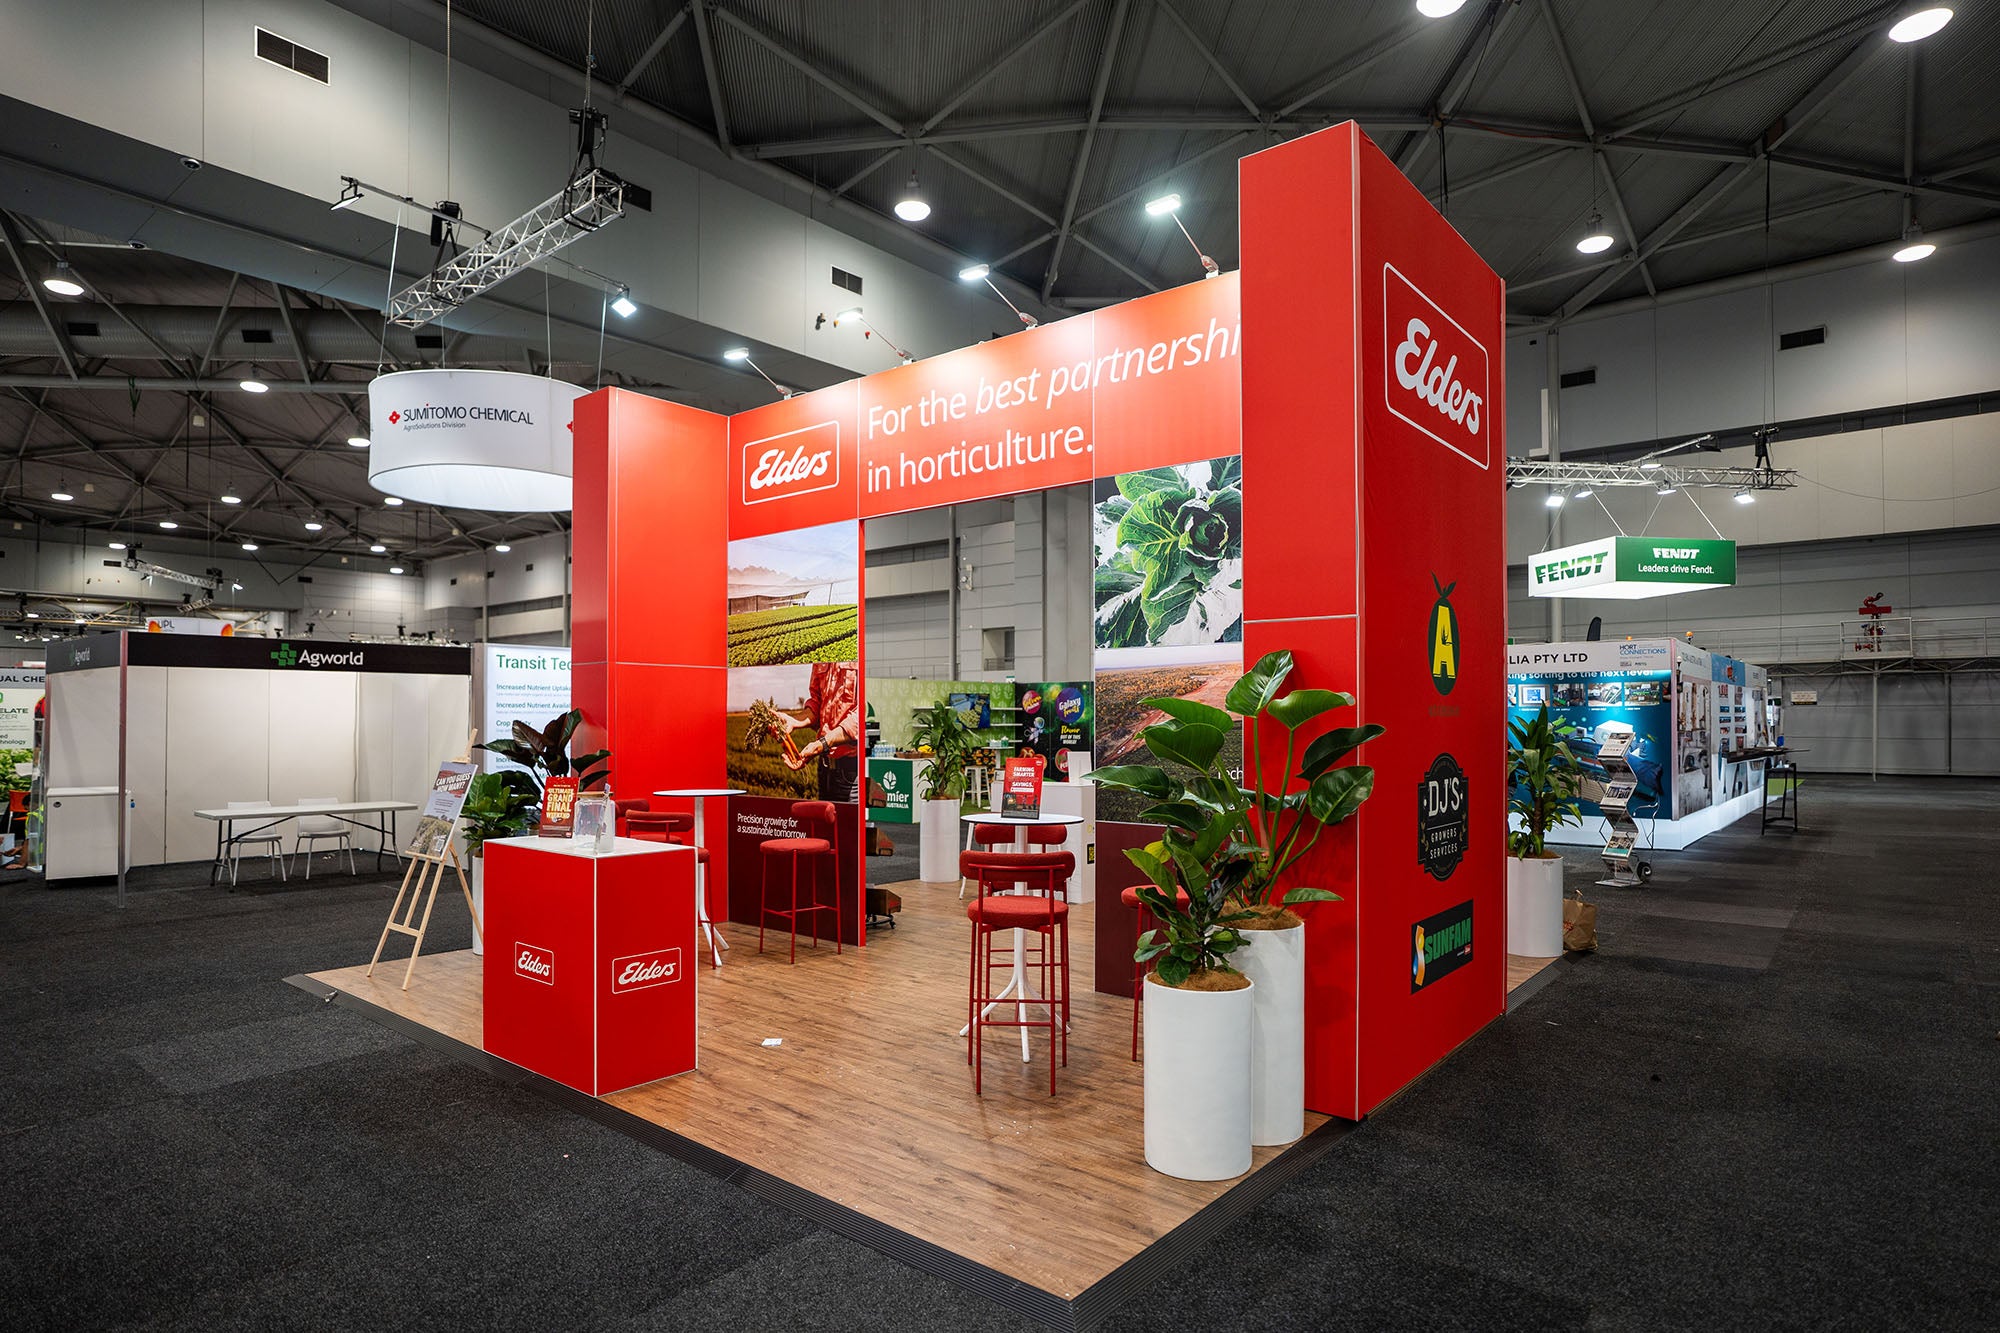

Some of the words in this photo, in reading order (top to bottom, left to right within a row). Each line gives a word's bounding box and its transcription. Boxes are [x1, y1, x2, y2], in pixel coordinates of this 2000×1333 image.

[868, 404, 913, 440] For
[918, 389, 967, 428] the
[975, 367, 1041, 415] best
[1046, 313, 1241, 410] partnershi
[1395, 318, 1483, 435] Elders
[403, 403, 467, 422] SUMITOMO
[469, 406, 534, 425] CHEMICAL
[442, 421, 466, 429] Division
[750, 445, 832, 490] Elders
[868, 460, 891, 493] in
[900, 425, 1094, 487] horticulture.
[1652, 548, 1700, 559] FENDT
[1535, 551, 1608, 584] FENDT
[1638, 563, 1669, 573] Leaders
[1670, 564, 1690, 573] drive
[1690, 565, 1714, 574] Fendt.
[299, 649, 364, 667] Agworld
[1507, 655, 1530, 665] LIA
[1534, 653, 1559, 664] PTY
[1563, 652, 1588, 663] LTD
[1620, 648, 1667, 656] CONNECTIONS
[496, 654, 546, 670] Transit
[1600, 670, 1624, 678] next
[495, 719, 511, 728] Crop
[547, 793, 573, 802] GRAND
[1428, 777, 1459, 816] DJ'S
[546, 802, 571, 812] FINAL
[737, 812, 764, 824] Precision
[763, 816, 787, 829] growing
[788, 817, 798, 828] for
[737, 825, 742, 833] a
[742, 825, 773, 836] sustainable
[1431, 827, 1457, 843] GROWERS
[1430, 842, 1458, 859] SERVICES
[1424, 917, 1471, 965] SUNFAM
[517, 950, 550, 977] Elders
[618, 960, 676, 985] Elders
